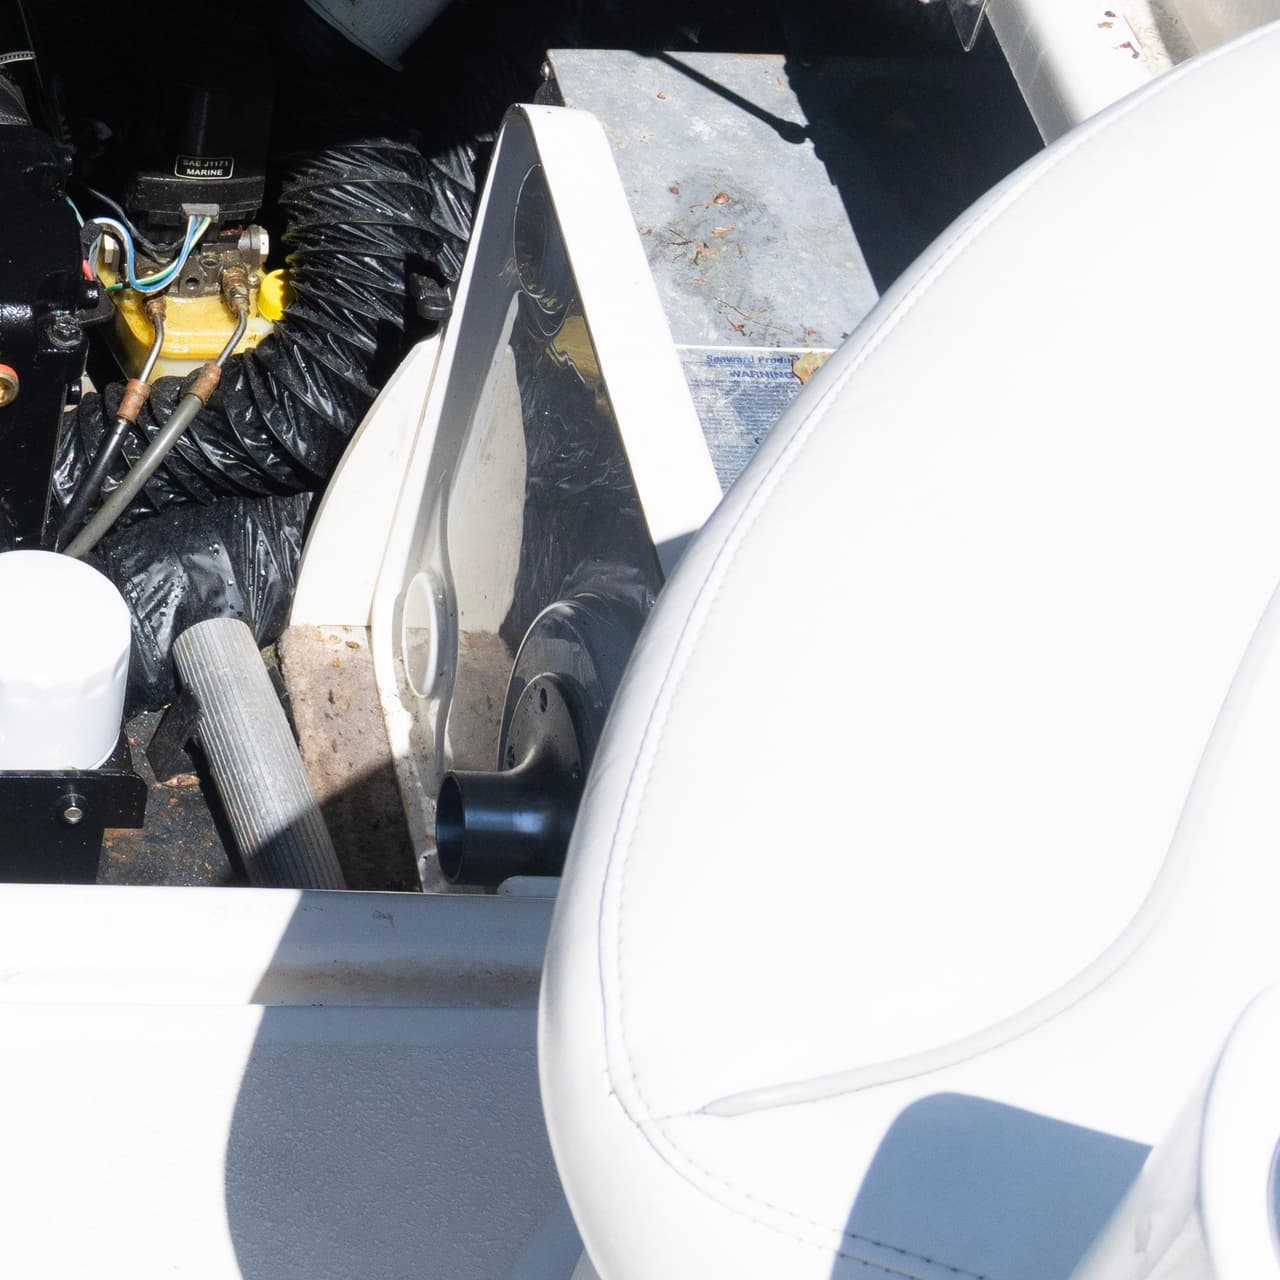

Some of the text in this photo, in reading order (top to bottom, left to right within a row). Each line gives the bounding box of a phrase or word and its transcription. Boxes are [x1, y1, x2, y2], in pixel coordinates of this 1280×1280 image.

[186, 168, 223, 176] MARINE
[706, 354, 755, 365] Seaward
[729, 369, 795, 380] WARNING
